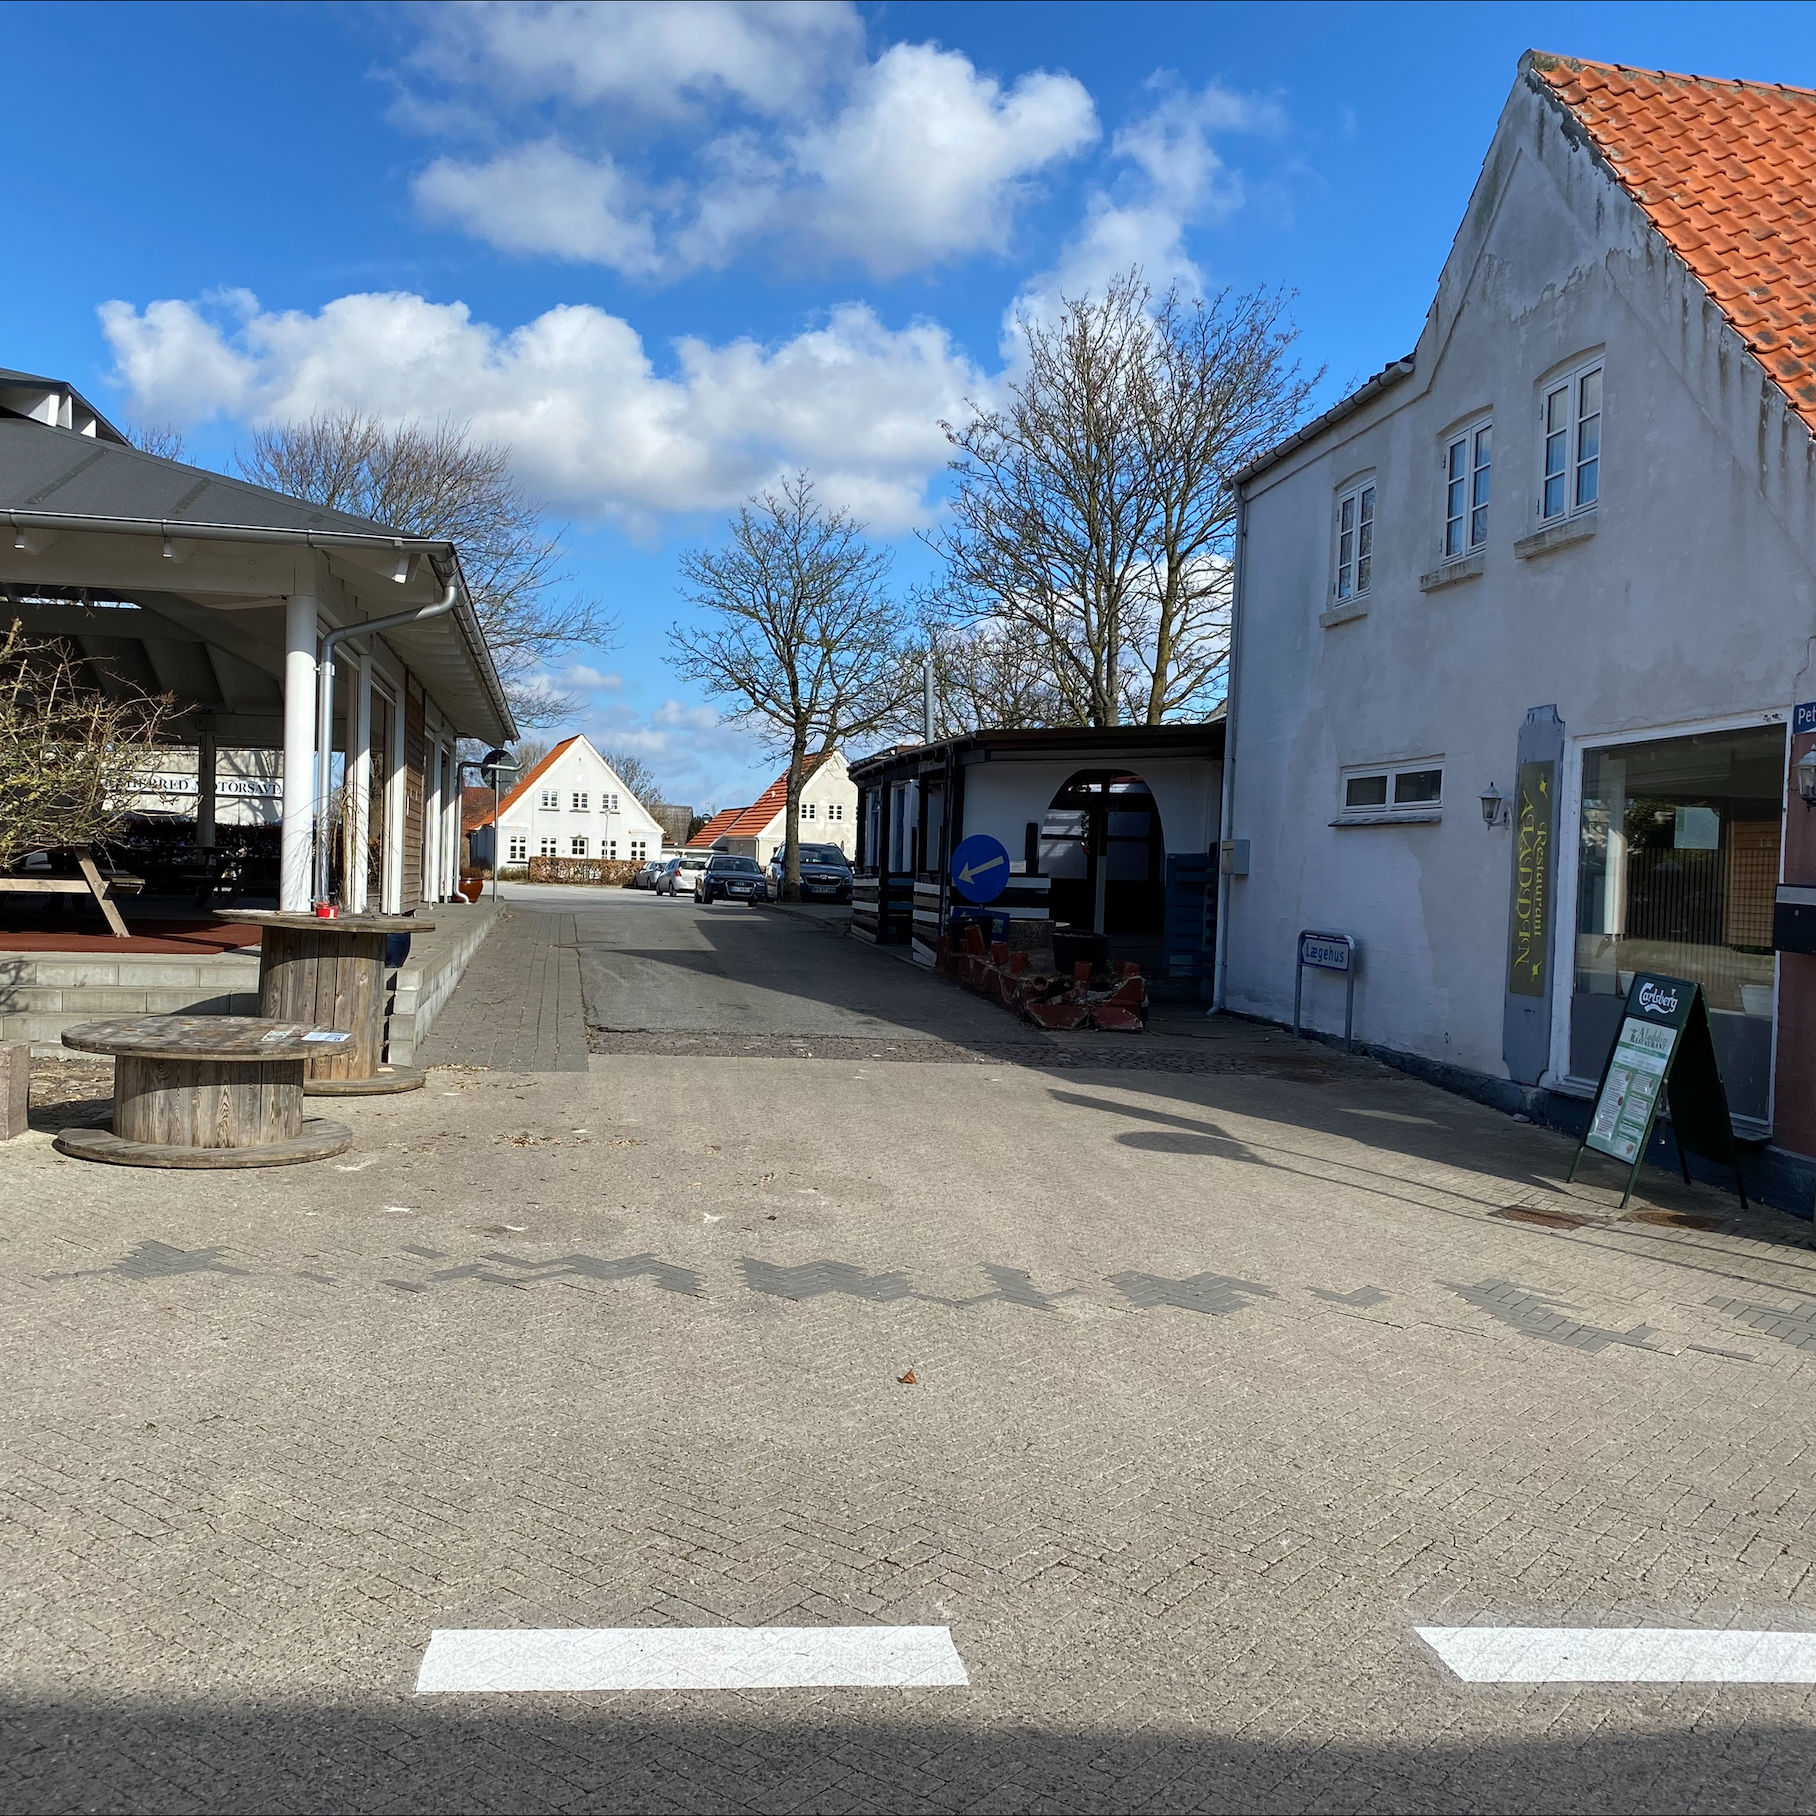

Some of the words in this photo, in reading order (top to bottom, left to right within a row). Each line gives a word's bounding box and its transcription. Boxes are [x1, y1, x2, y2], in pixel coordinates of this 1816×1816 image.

[1532, 821, 1548, 936] Restaurant
[1305, 942, 1345, 963] Lægehus
[1639, 982, 1678, 1014] Carlsberg
